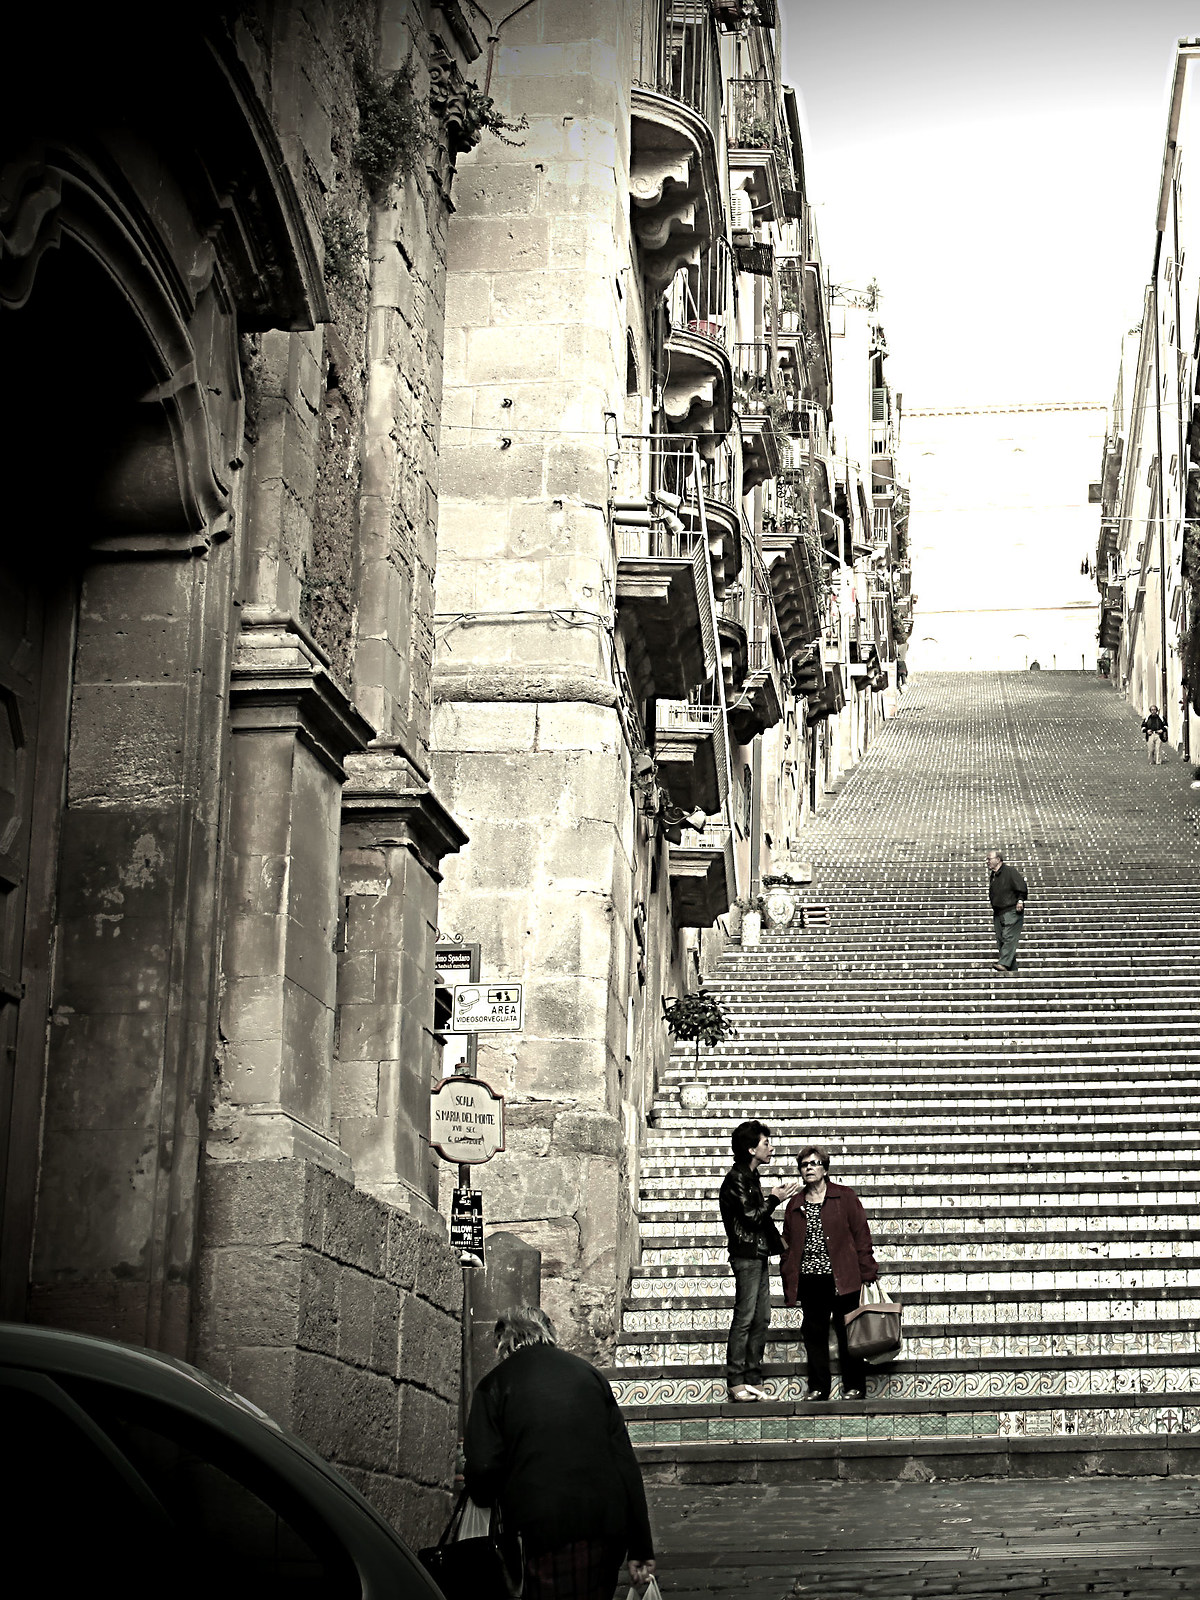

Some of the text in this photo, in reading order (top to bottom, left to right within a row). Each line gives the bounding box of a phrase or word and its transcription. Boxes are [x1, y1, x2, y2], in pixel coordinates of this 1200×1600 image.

[448, 954, 470, 963] Spadaro
[491, 1006, 516, 1014] AREA
[461, 1112, 474, 1123] DEL
[475, 1113, 495, 1125] MONTE
